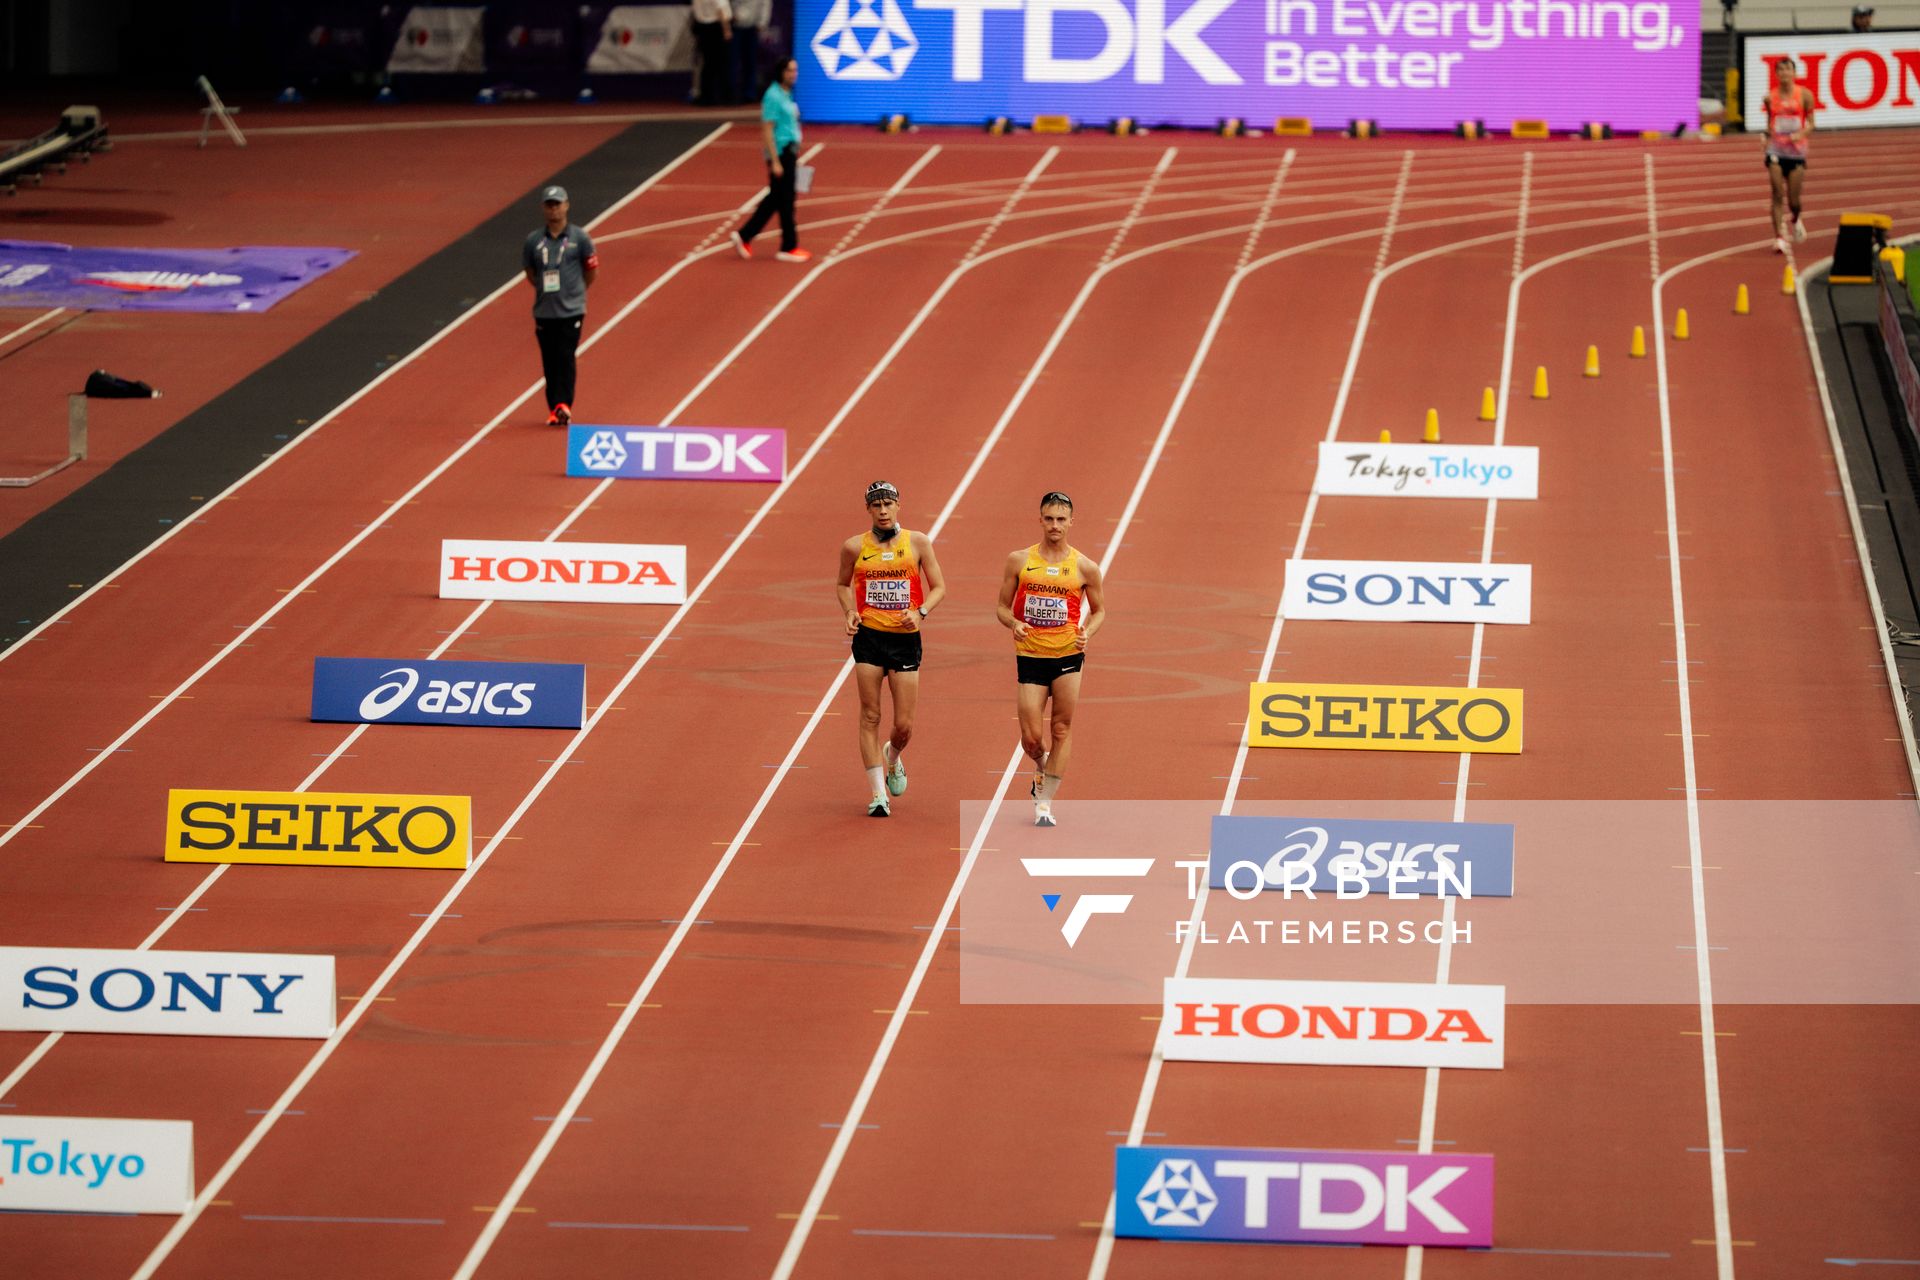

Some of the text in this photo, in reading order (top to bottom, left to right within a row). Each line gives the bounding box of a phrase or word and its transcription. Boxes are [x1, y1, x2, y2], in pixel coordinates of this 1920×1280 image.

[913, 0, 1244, 85] TDK
[1264, 0, 1684, 50] In Everything,
[1264, 41, 1463, 88] Better
[625, 432, 772, 473] TDK
[448, 556, 676, 585] HONDA
[865, 569, 907, 578] GERMANY
[877, 581, 906, 590] TDK
[1026, 582, 1070, 595] GERMANY
[1306, 573, 1509, 607] SONY
[868, 592, 899, 602] FRENZL
[1025, 606, 1057, 619] HILBERT
[1037, 598, 1064, 608] TDK
[417, 680, 536, 716] asics
[1260, 693, 1511, 743] SEIKO
[179, 801, 456, 855] SEIKO
[23, 966, 304, 1014] SONY
[1174, 1003, 1493, 1043] HONDA
[2, 1138, 145, 1188] Tokyo
[1214, 1160, 1470, 1234] TDK
